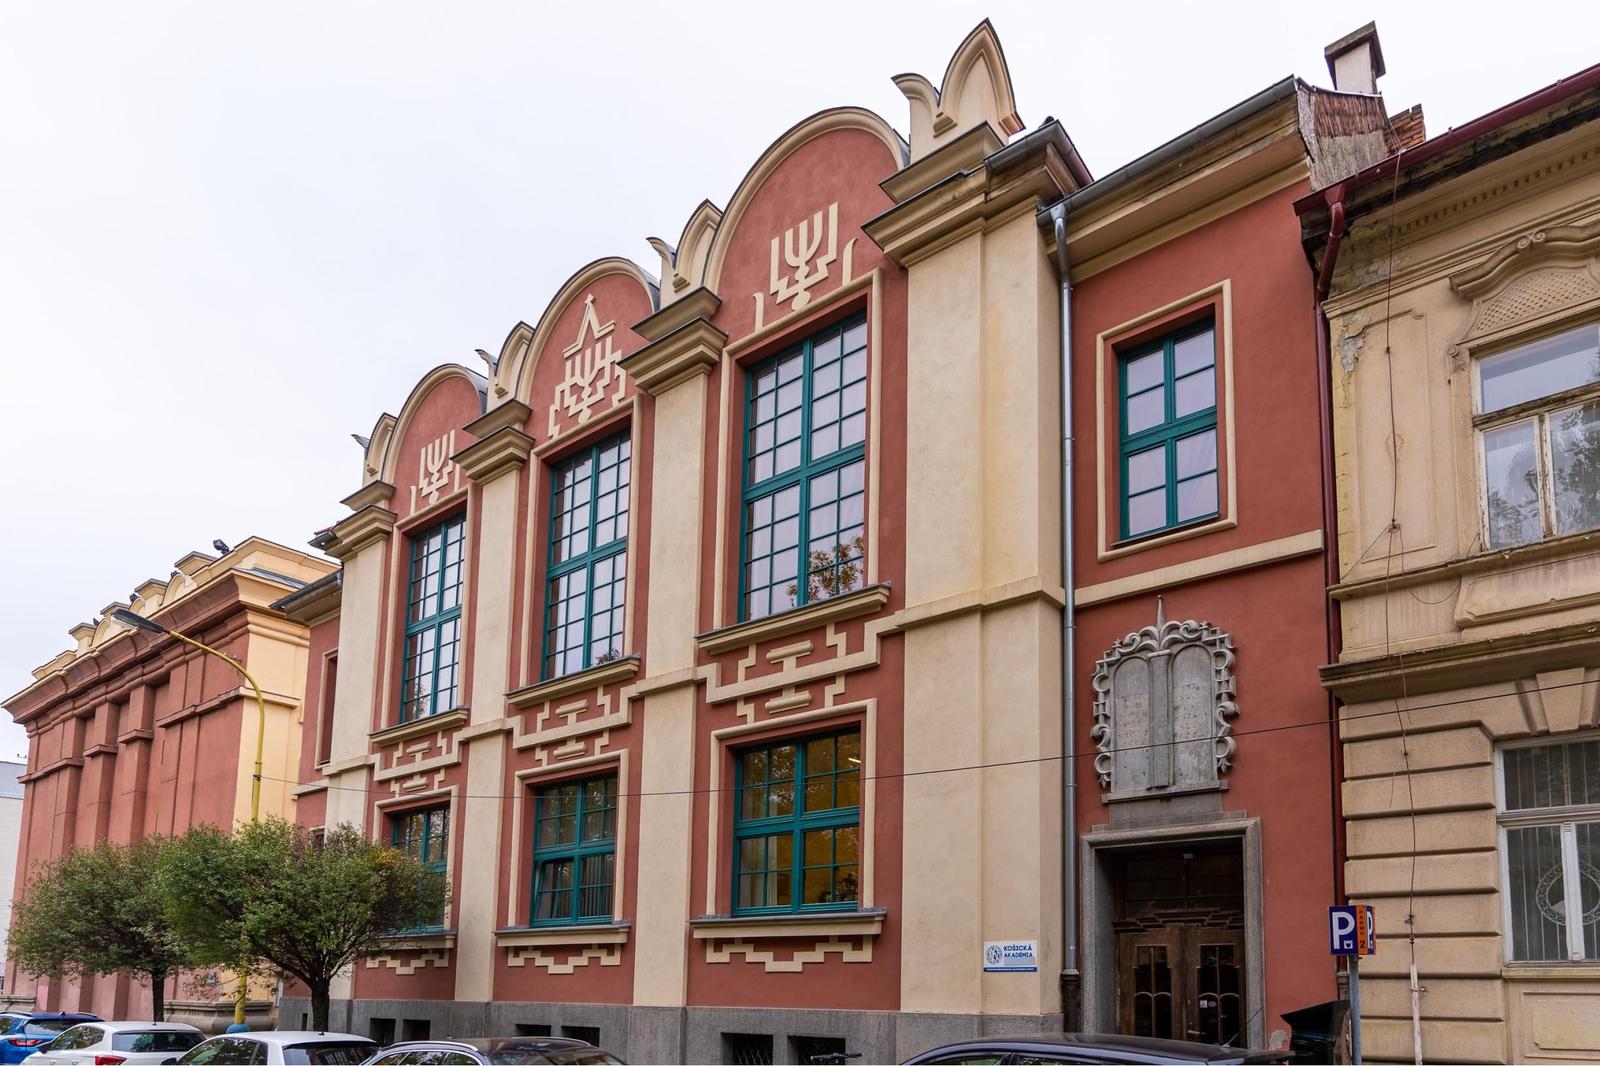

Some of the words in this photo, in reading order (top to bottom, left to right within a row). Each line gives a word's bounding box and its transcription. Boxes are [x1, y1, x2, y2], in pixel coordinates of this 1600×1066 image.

[1331, 911, 1355, 950] P
[1359, 940, 1366, 949] 2
[1366, 911, 1373, 949] P
